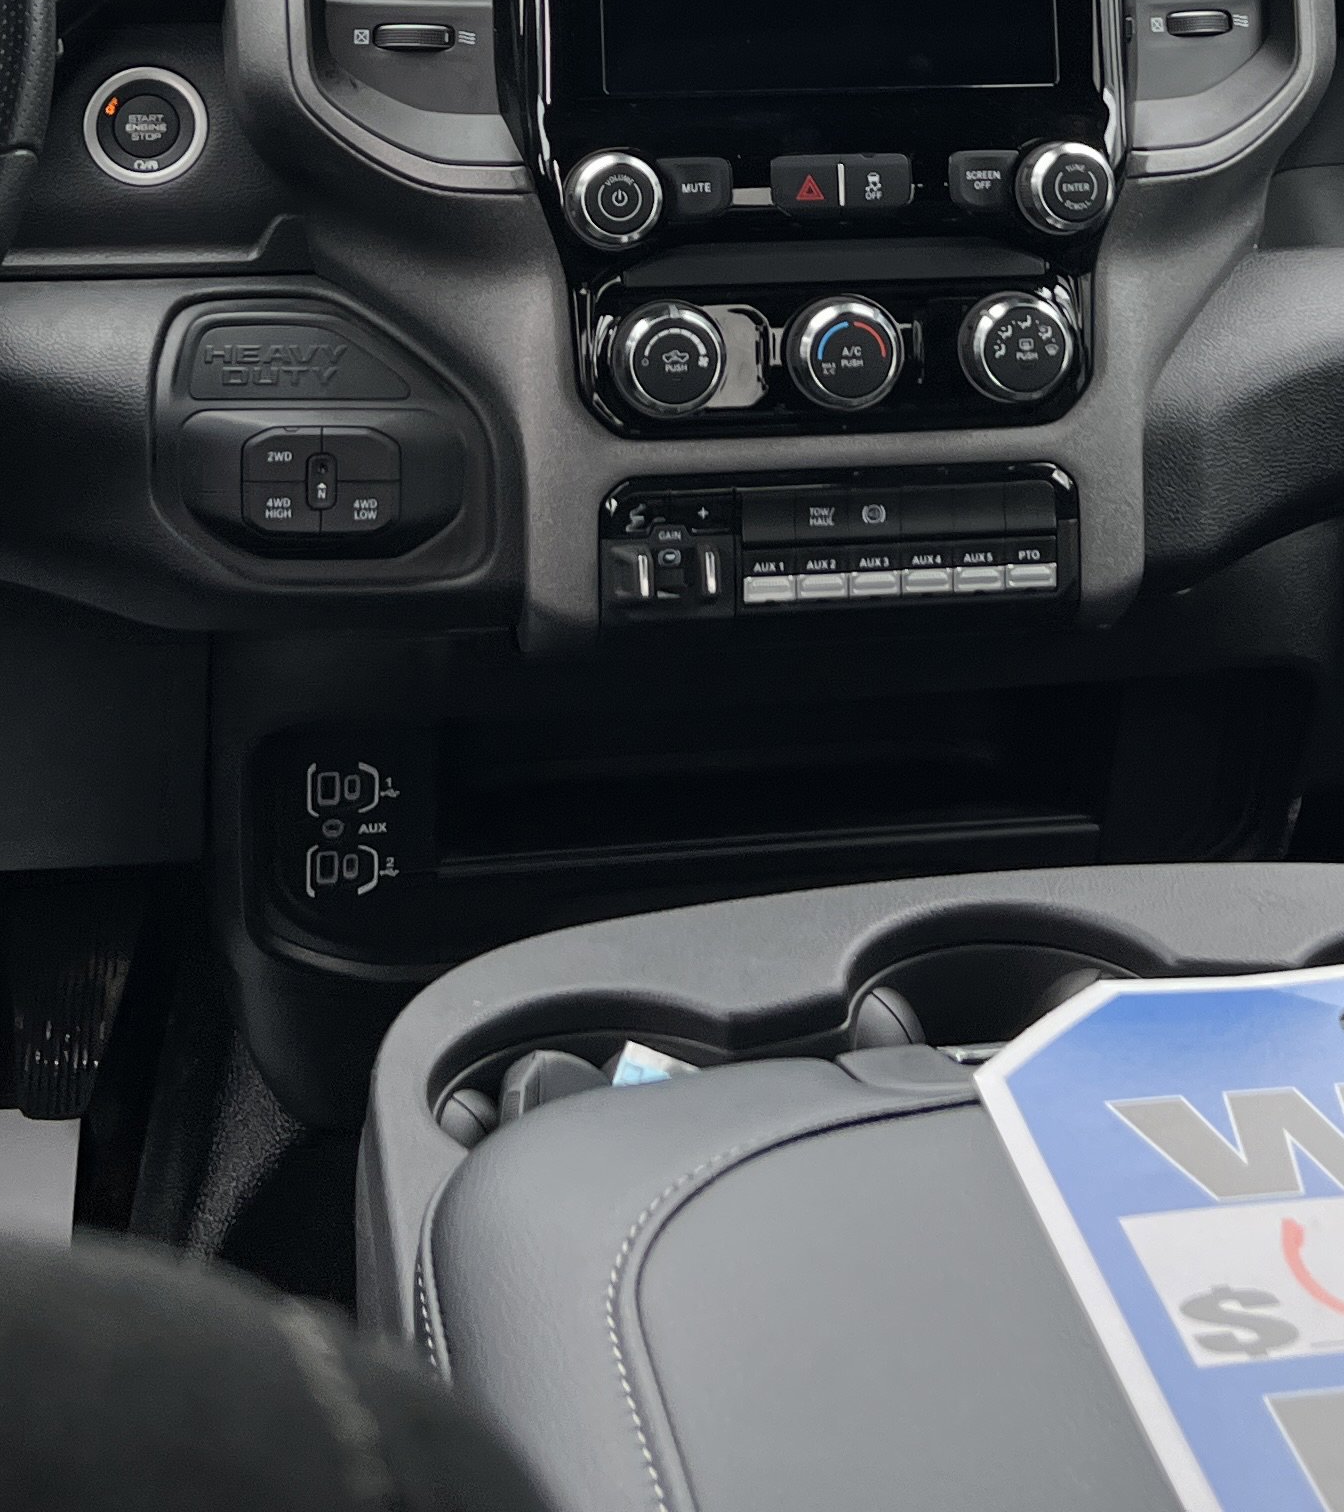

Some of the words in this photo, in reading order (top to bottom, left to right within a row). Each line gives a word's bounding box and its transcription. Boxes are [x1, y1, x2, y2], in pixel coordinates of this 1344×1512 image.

[128, 114, 165, 123] START
[125, 123, 168, 133] ENGINE
[131, 133, 163, 141] STOP
[605, 174, 635, 187] VOLUME
[965, 170, 1002, 180] SCREEN
[681, 182, 712, 193] MUTE
[973, 180, 992, 190] OFF
[1062, 182, 1091, 193] ENTER
[865, 191, 883, 201] OFF
[205, 344, 348, 365] HEAVY
[842, 346, 862, 357] A/C
[664, 363, 689, 373] PUSH
[840, 359, 864, 368] PUSH
[222, 366, 340, 386] DUTY
[267, 451, 293, 462] 2WD
[317, 489, 327, 499] N
[266, 498, 292, 508] 4WD
[353, 498, 378, 509] 4WD
[265, 508, 292, 519] HIGH
[354, 509, 378, 520] LOW
[809, 507, 836, 518] TOW/
[809, 517, 835, 527] HAUL
[658, 530, 682, 541] GAIN
[912, 555, 934, 565] AUX
[963, 552, 985, 563] AUX
[1018, 549, 1042, 561] PTO
[753, 562, 776, 573] AUX
[806, 560, 828, 570] AUX
[859, 557, 882, 568] AUX
[385, 777, 393, 788] 1
[358, 822, 388, 835] AUX
[385, 857, 395, 868] 2
[1176, 1286, 1301, 1359] $
